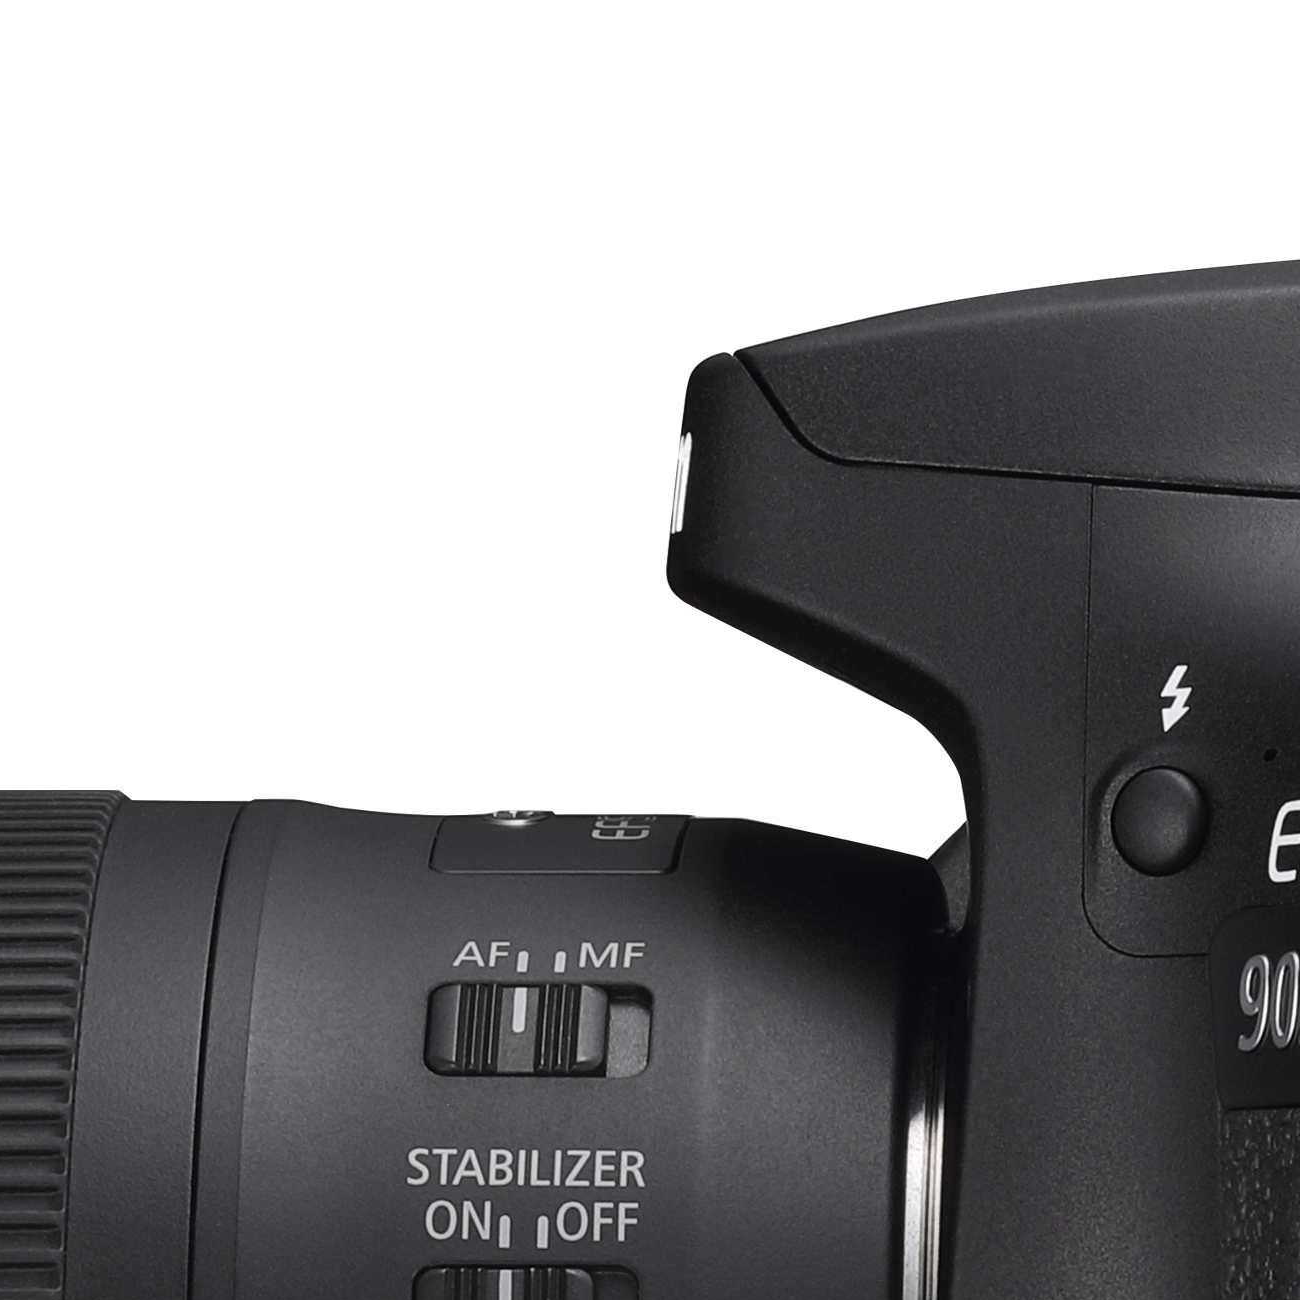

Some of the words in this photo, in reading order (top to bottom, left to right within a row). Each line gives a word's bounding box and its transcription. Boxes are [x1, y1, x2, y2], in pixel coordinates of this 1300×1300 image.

[452, 941, 511, 968] AF
[578, 941, 646, 969] MF
[406, 1147, 646, 1188] STABILIZER
[425, 1200, 492, 1241] ON
[556, 1201, 639, 1242] OFF
